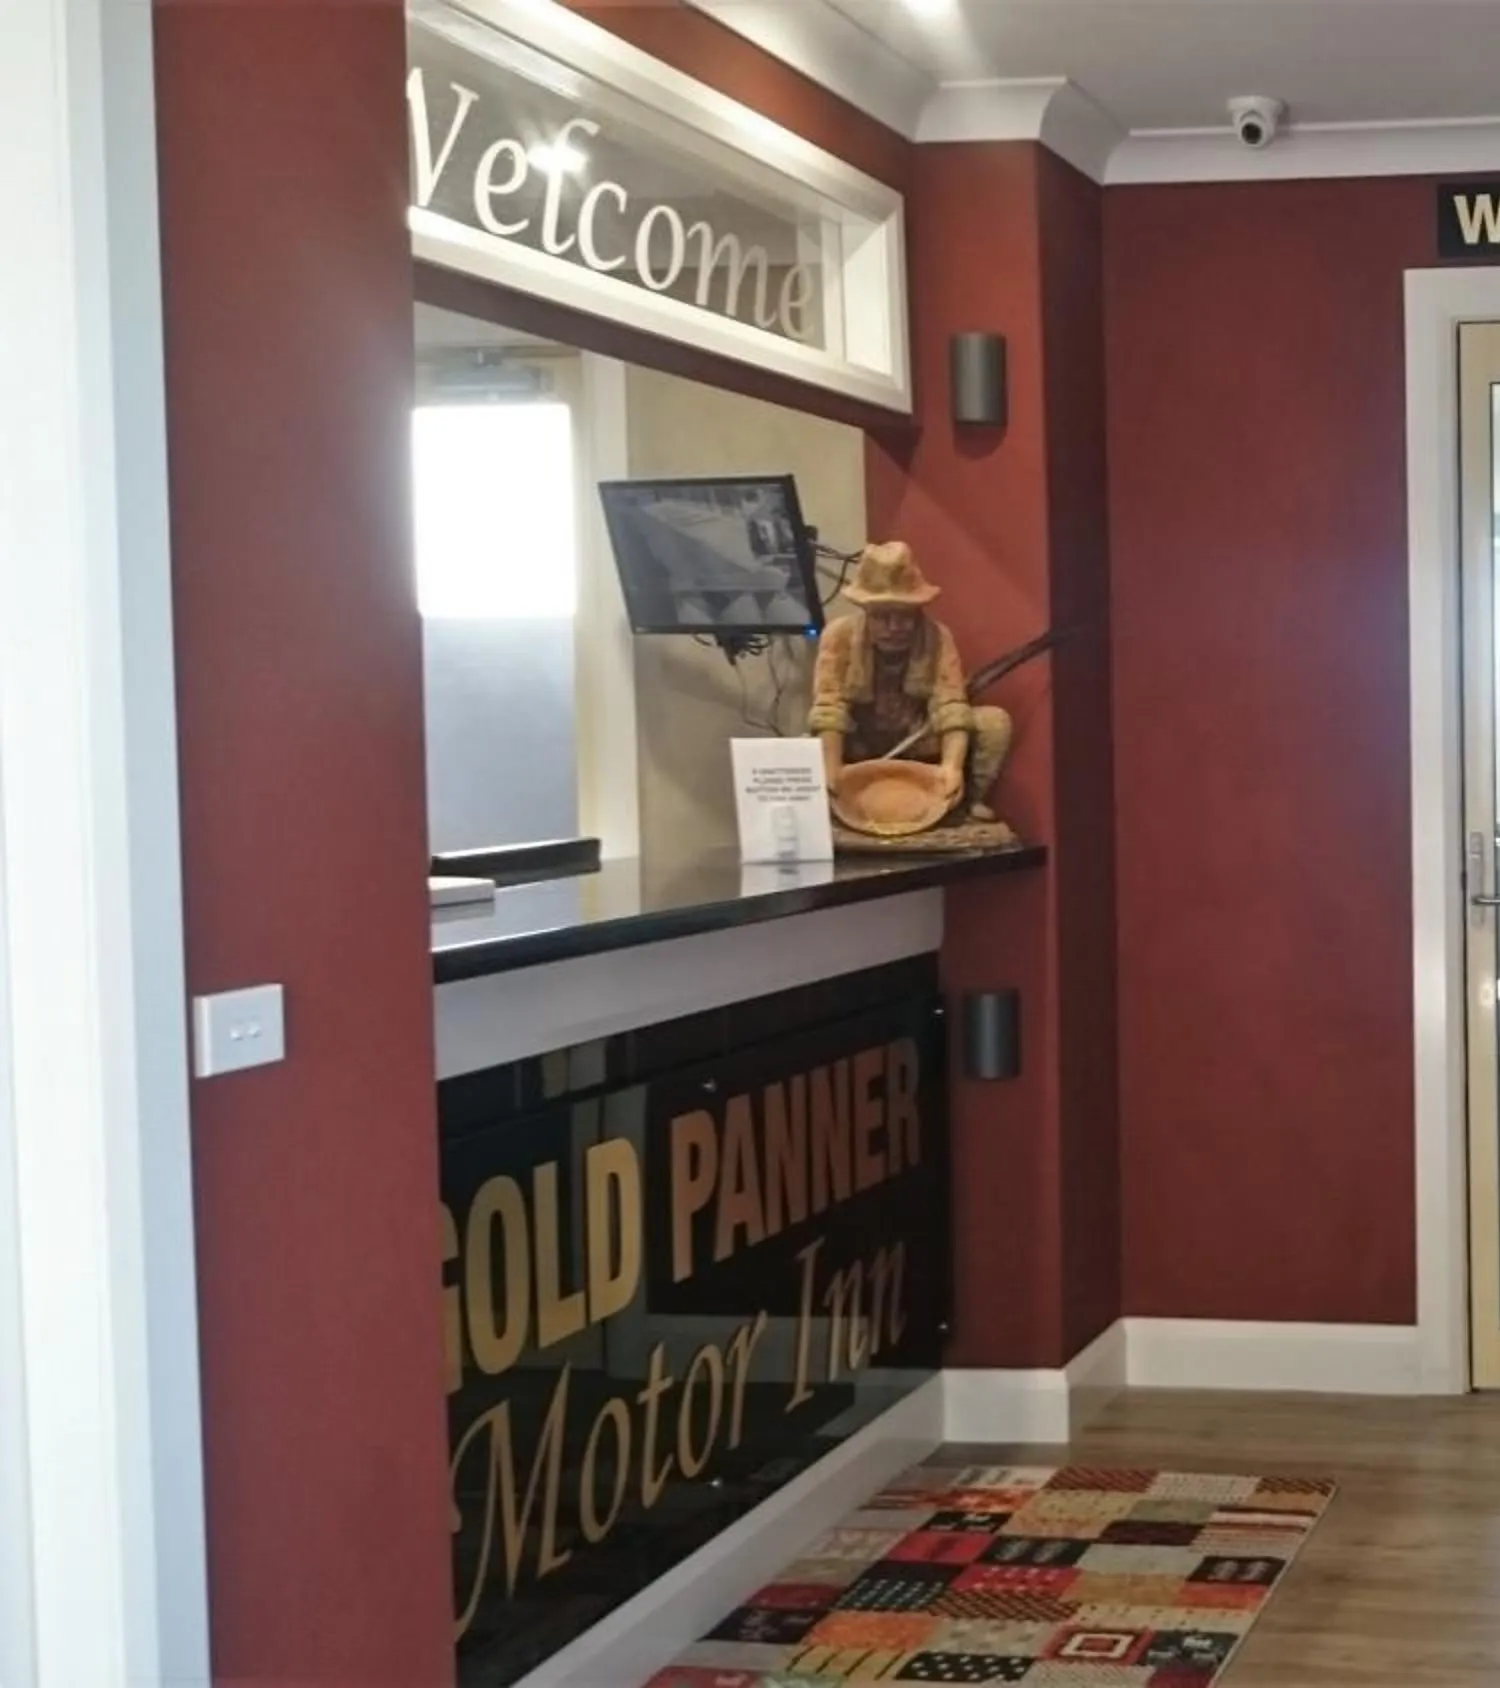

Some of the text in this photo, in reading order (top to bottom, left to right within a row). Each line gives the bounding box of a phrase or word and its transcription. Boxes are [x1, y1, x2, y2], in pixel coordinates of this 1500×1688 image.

[671, 1037, 919, 1284] PANNER
[450, 1236, 908, 1642] Motor Inn
